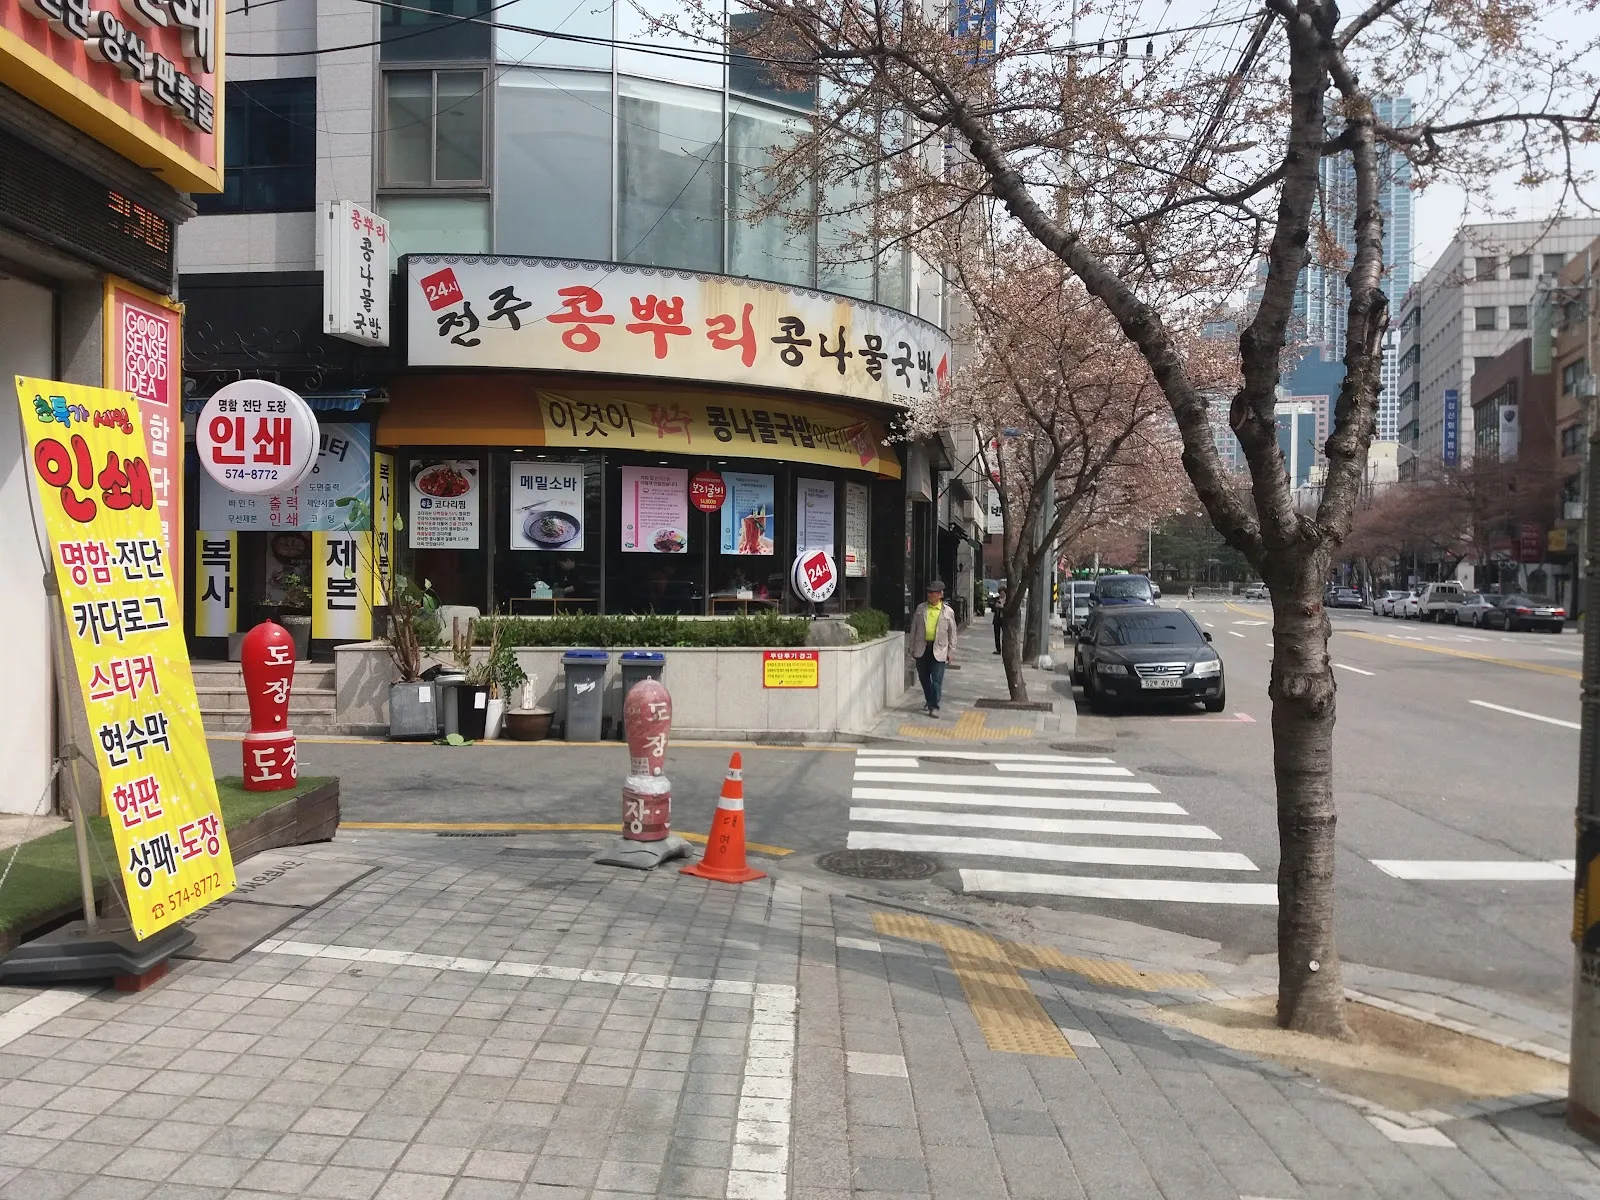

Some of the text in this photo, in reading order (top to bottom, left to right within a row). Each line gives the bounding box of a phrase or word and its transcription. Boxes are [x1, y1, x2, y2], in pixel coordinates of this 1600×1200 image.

[351, 209, 386, 244] 콩뿌리
[426, 280, 460, 302] 24시
[126, 311, 167, 342] GOOD
[436, 285, 533, 348] 전주
[546, 285, 757, 369] 콩뿌리
[770, 315, 934, 394] 콩나물국밥
[126, 331, 167, 362] SENSE
[126, 351, 167, 381] GOOD
[126, 370, 158, 399] IDEA
[218, 399, 287, 414] 명함 전단 도장
[549, 401, 636, 438] 이것이
[208, 415, 293, 466] 인쇄
[34, 433, 154, 523] 인쇄
[224, 468, 279, 480] 574-8772
[520, 474, 577, 492] 메밀소바
[692, 482, 724, 498] 보리굴비
[269, 496, 299, 511] 출력
[269, 512, 299, 527] 인쇄
[201, 539, 235, 609] 복사
[326, 539, 358, 611] 제본
[808, 563, 830, 583] 24시
[73, 597, 169, 645] 카다로그
[90, 655, 159, 701] 스티커
[263, 645, 293, 704] 도장
[99, 712, 171, 768] 현수막
[112, 776, 163, 828] 현판
[168, 872, 221, 911] 574-8772
